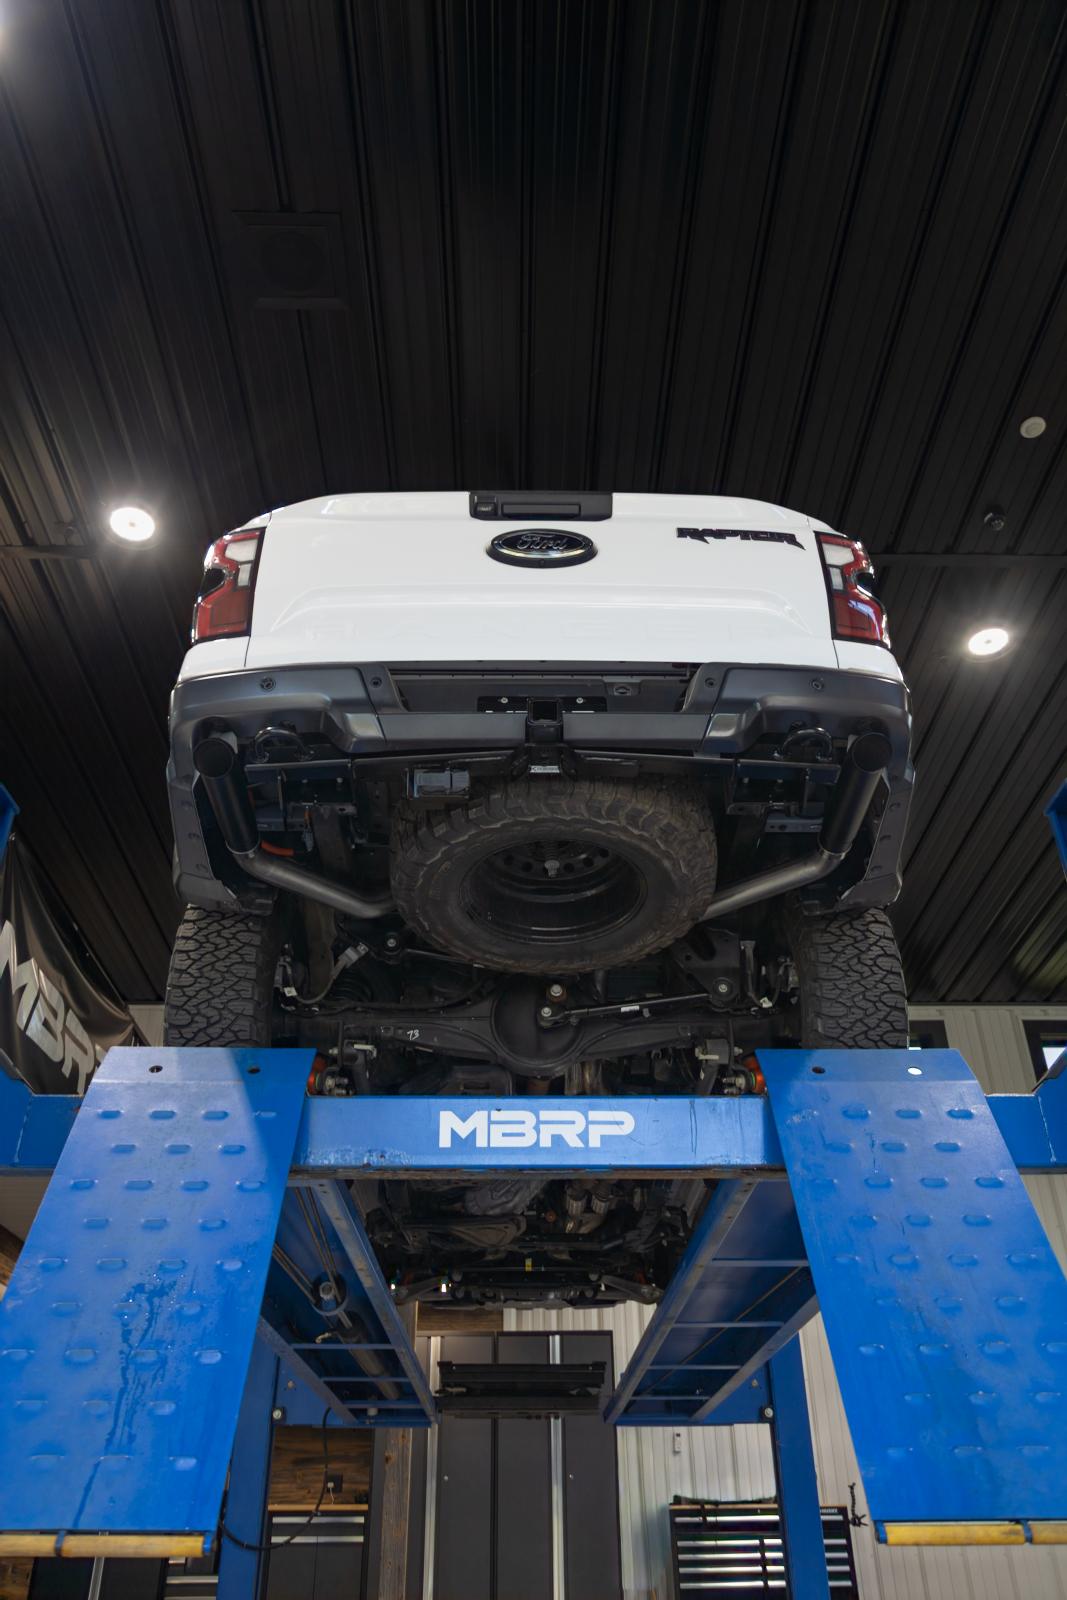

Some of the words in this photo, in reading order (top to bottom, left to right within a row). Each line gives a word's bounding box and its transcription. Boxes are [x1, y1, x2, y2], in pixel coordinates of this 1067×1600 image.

[516, 532, 568, 549] Ford
[676, 527, 806, 551] RAPTOR
[0, 919, 105, 1096] MBR
[438, 1110, 635, 1148] MBRP
